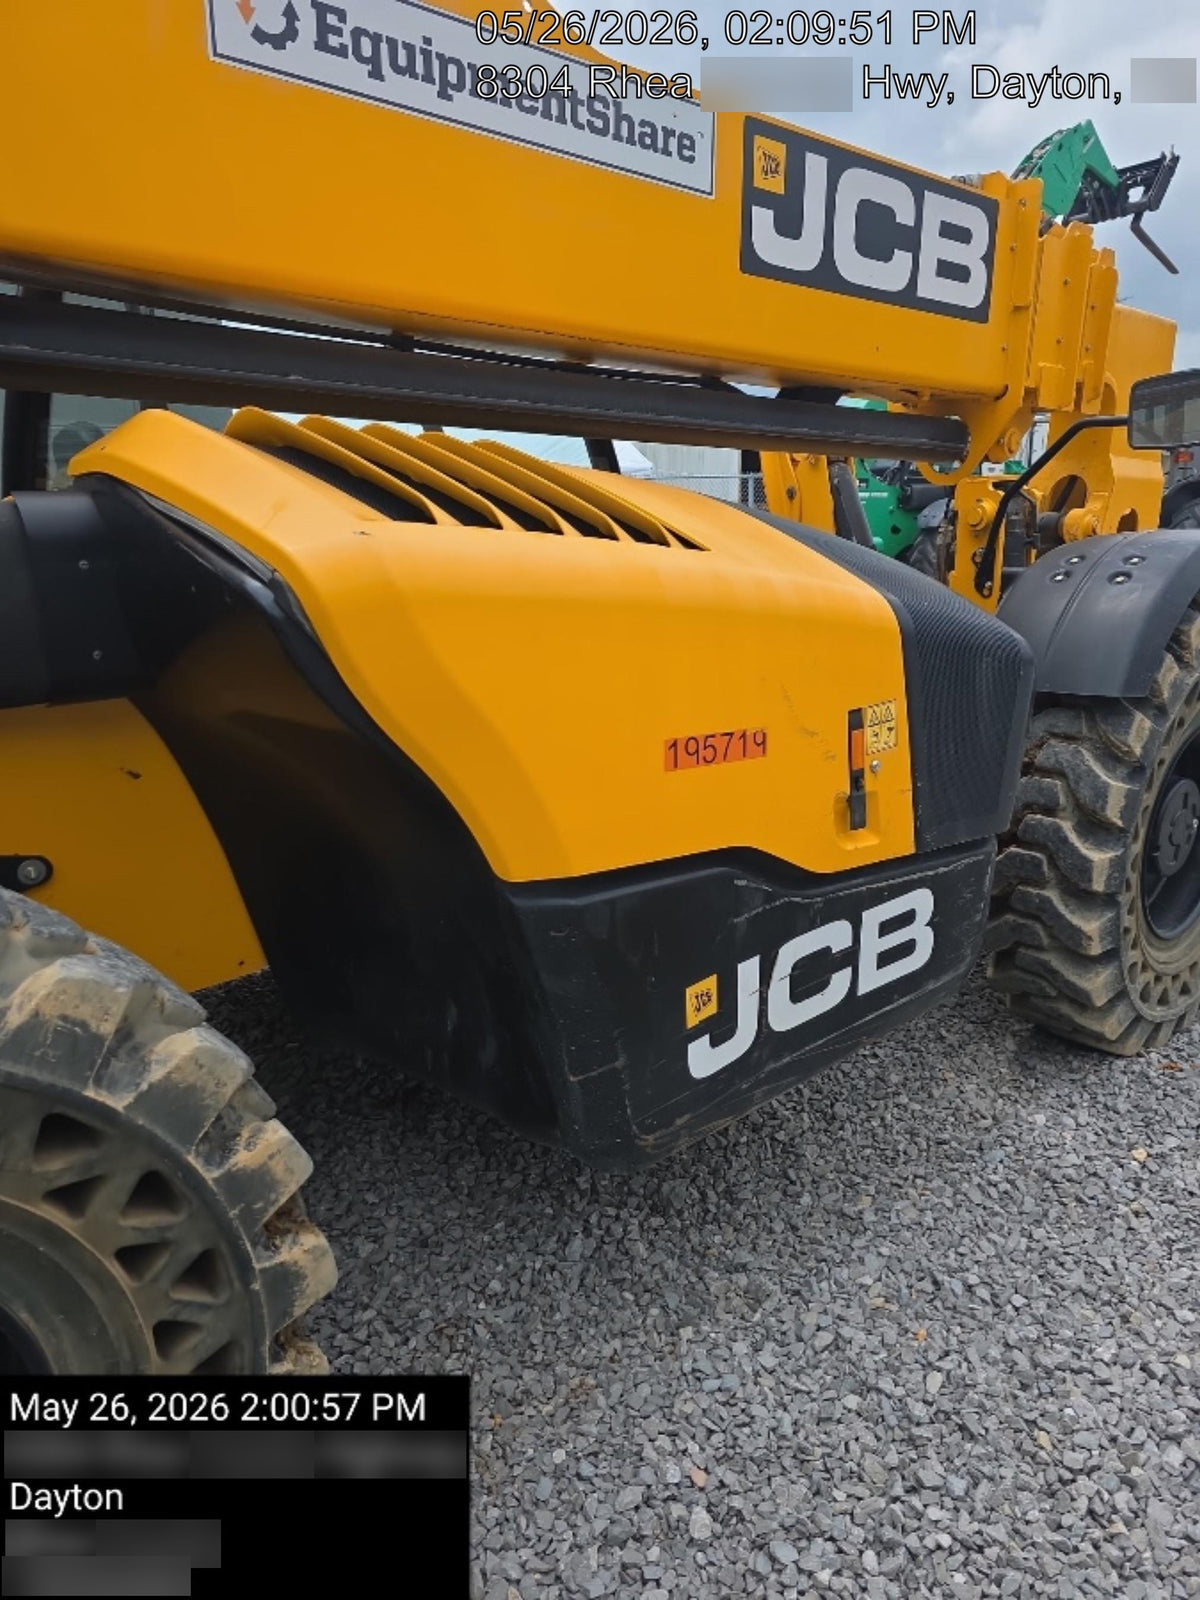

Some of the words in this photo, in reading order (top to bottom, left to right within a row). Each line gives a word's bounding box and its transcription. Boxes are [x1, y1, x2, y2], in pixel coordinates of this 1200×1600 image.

[311, 0, 697, 165] EquipmentShare
[751, 151, 989, 309] JCB
[667, 728, 768, 769] 195719
[687, 887, 935, 1080] JCB
